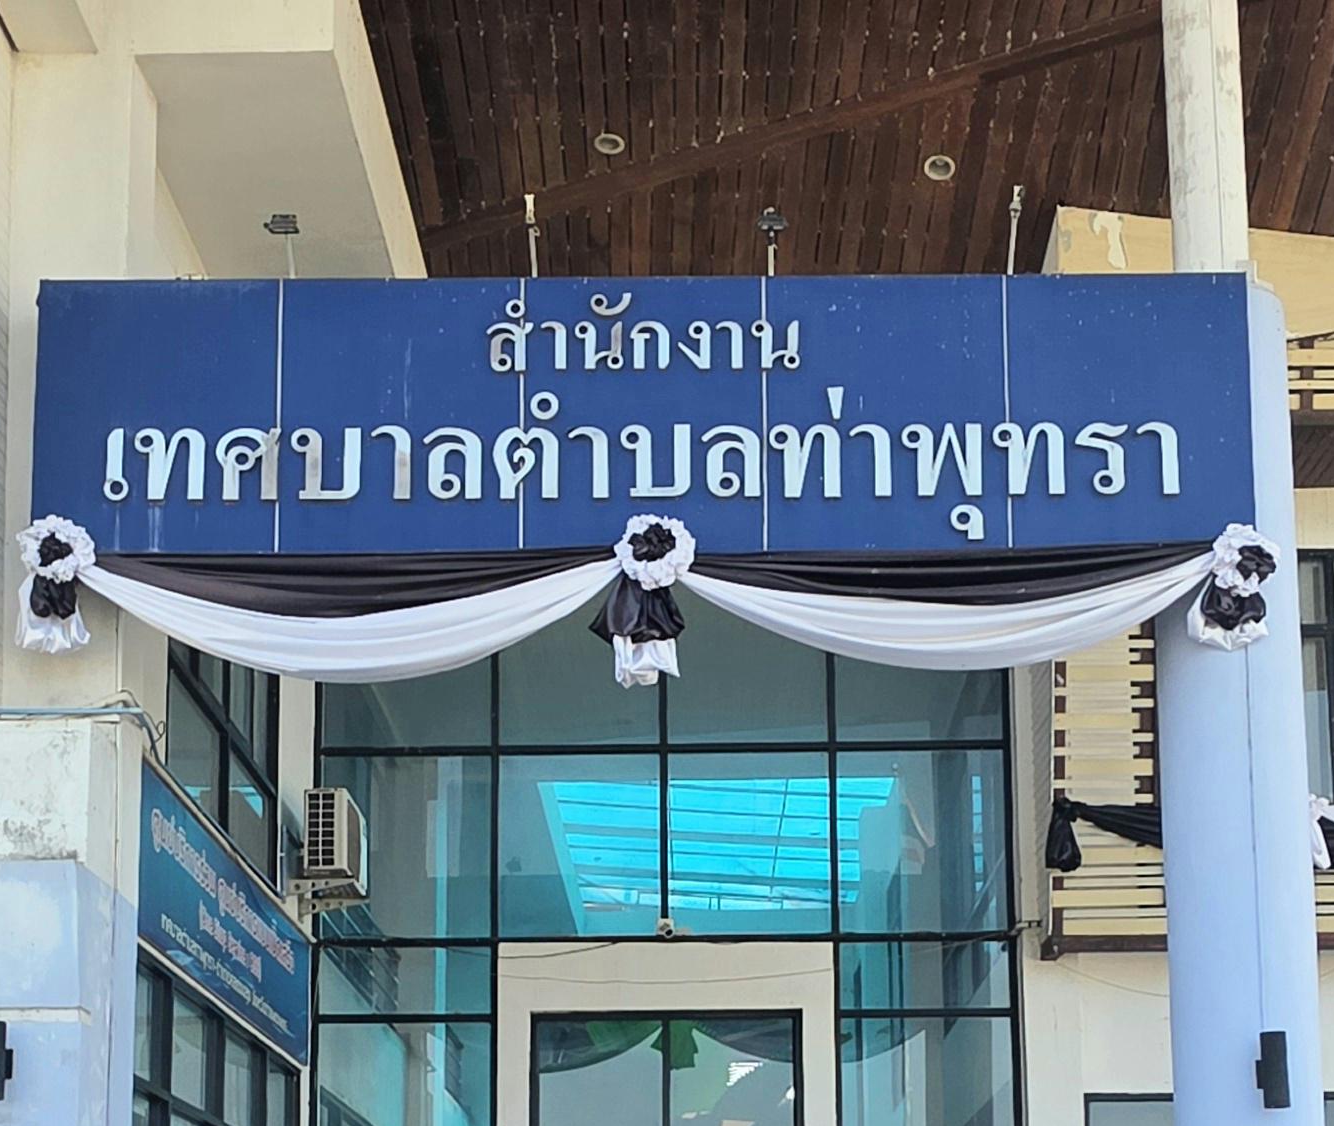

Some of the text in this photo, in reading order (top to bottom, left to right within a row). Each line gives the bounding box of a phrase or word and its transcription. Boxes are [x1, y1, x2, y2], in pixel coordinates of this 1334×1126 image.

[486, 292, 801, 373] สำนักงาน
[103, 387, 1181, 540] เทศบาลตำบลท่าพุทรา
